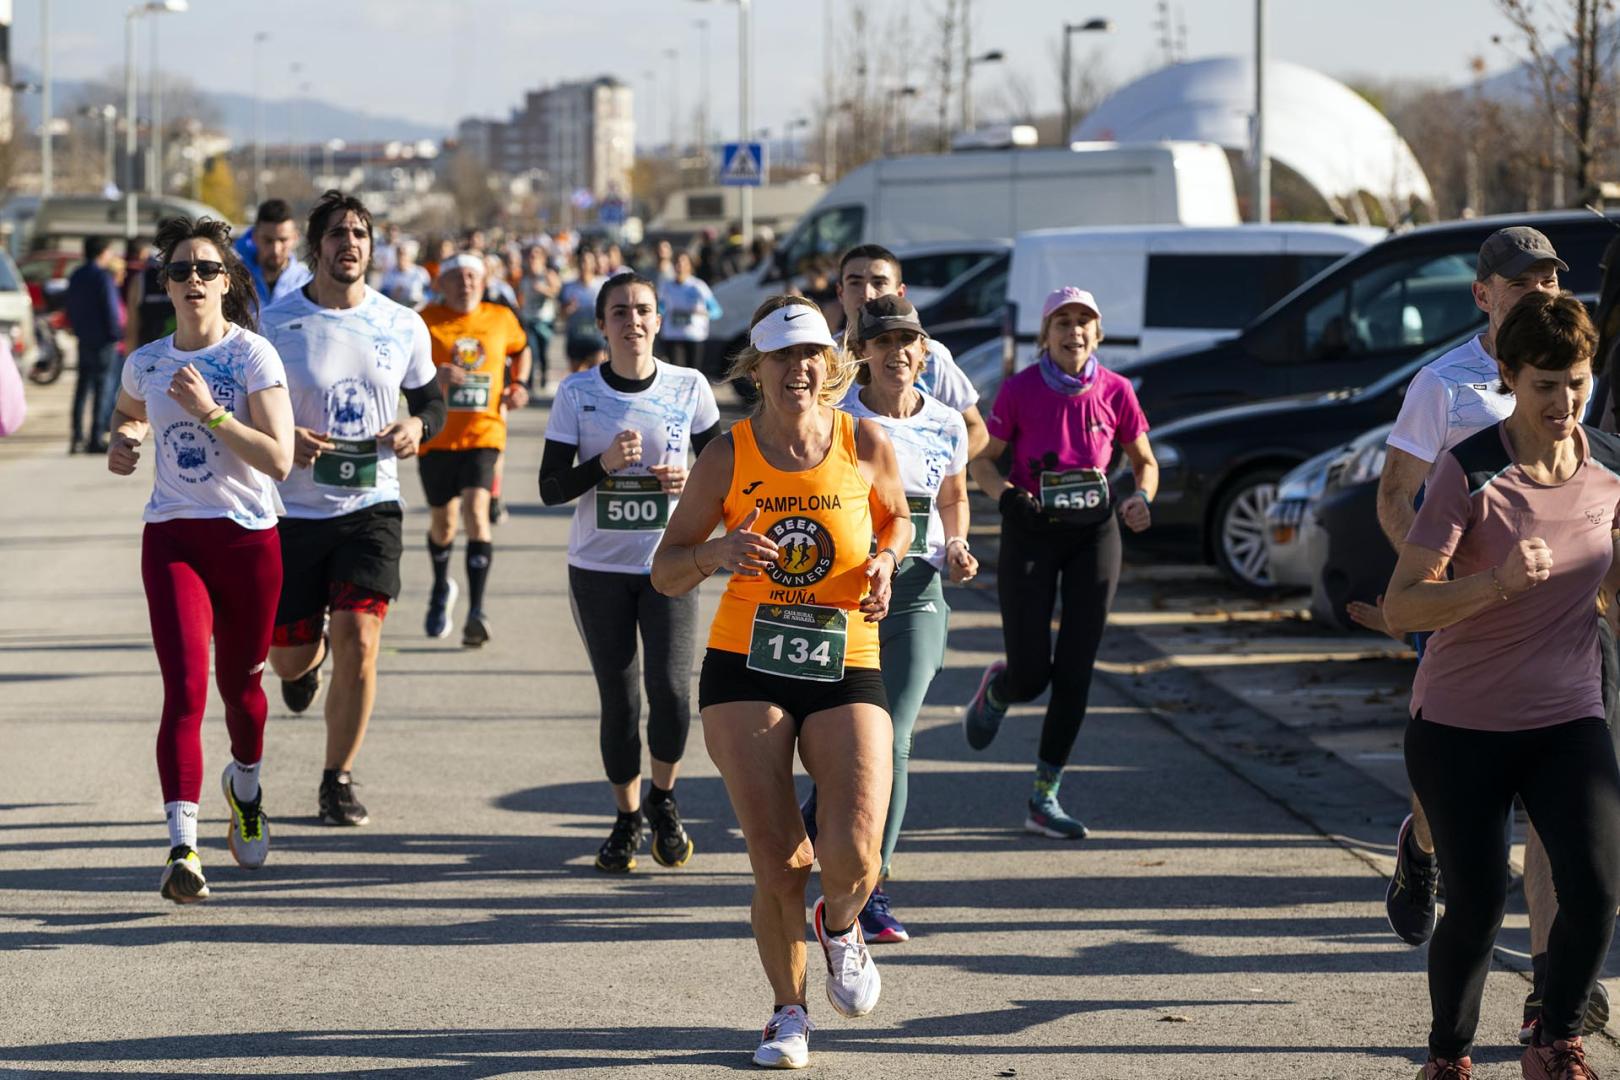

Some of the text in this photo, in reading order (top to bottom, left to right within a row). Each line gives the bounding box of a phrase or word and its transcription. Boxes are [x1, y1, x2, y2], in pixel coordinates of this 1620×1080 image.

[339, 461, 355, 479] 9
[755, 494, 842, 513] PAMPLONA
[1054, 489, 1100, 510] 656
[608, 500, 657, 521] 500
[773, 518, 818, 536] BEER
[766, 558, 831, 585] RUNNERS
[769, 589, 816, 605] IRUÑA
[768, 634, 831, 666] 134
